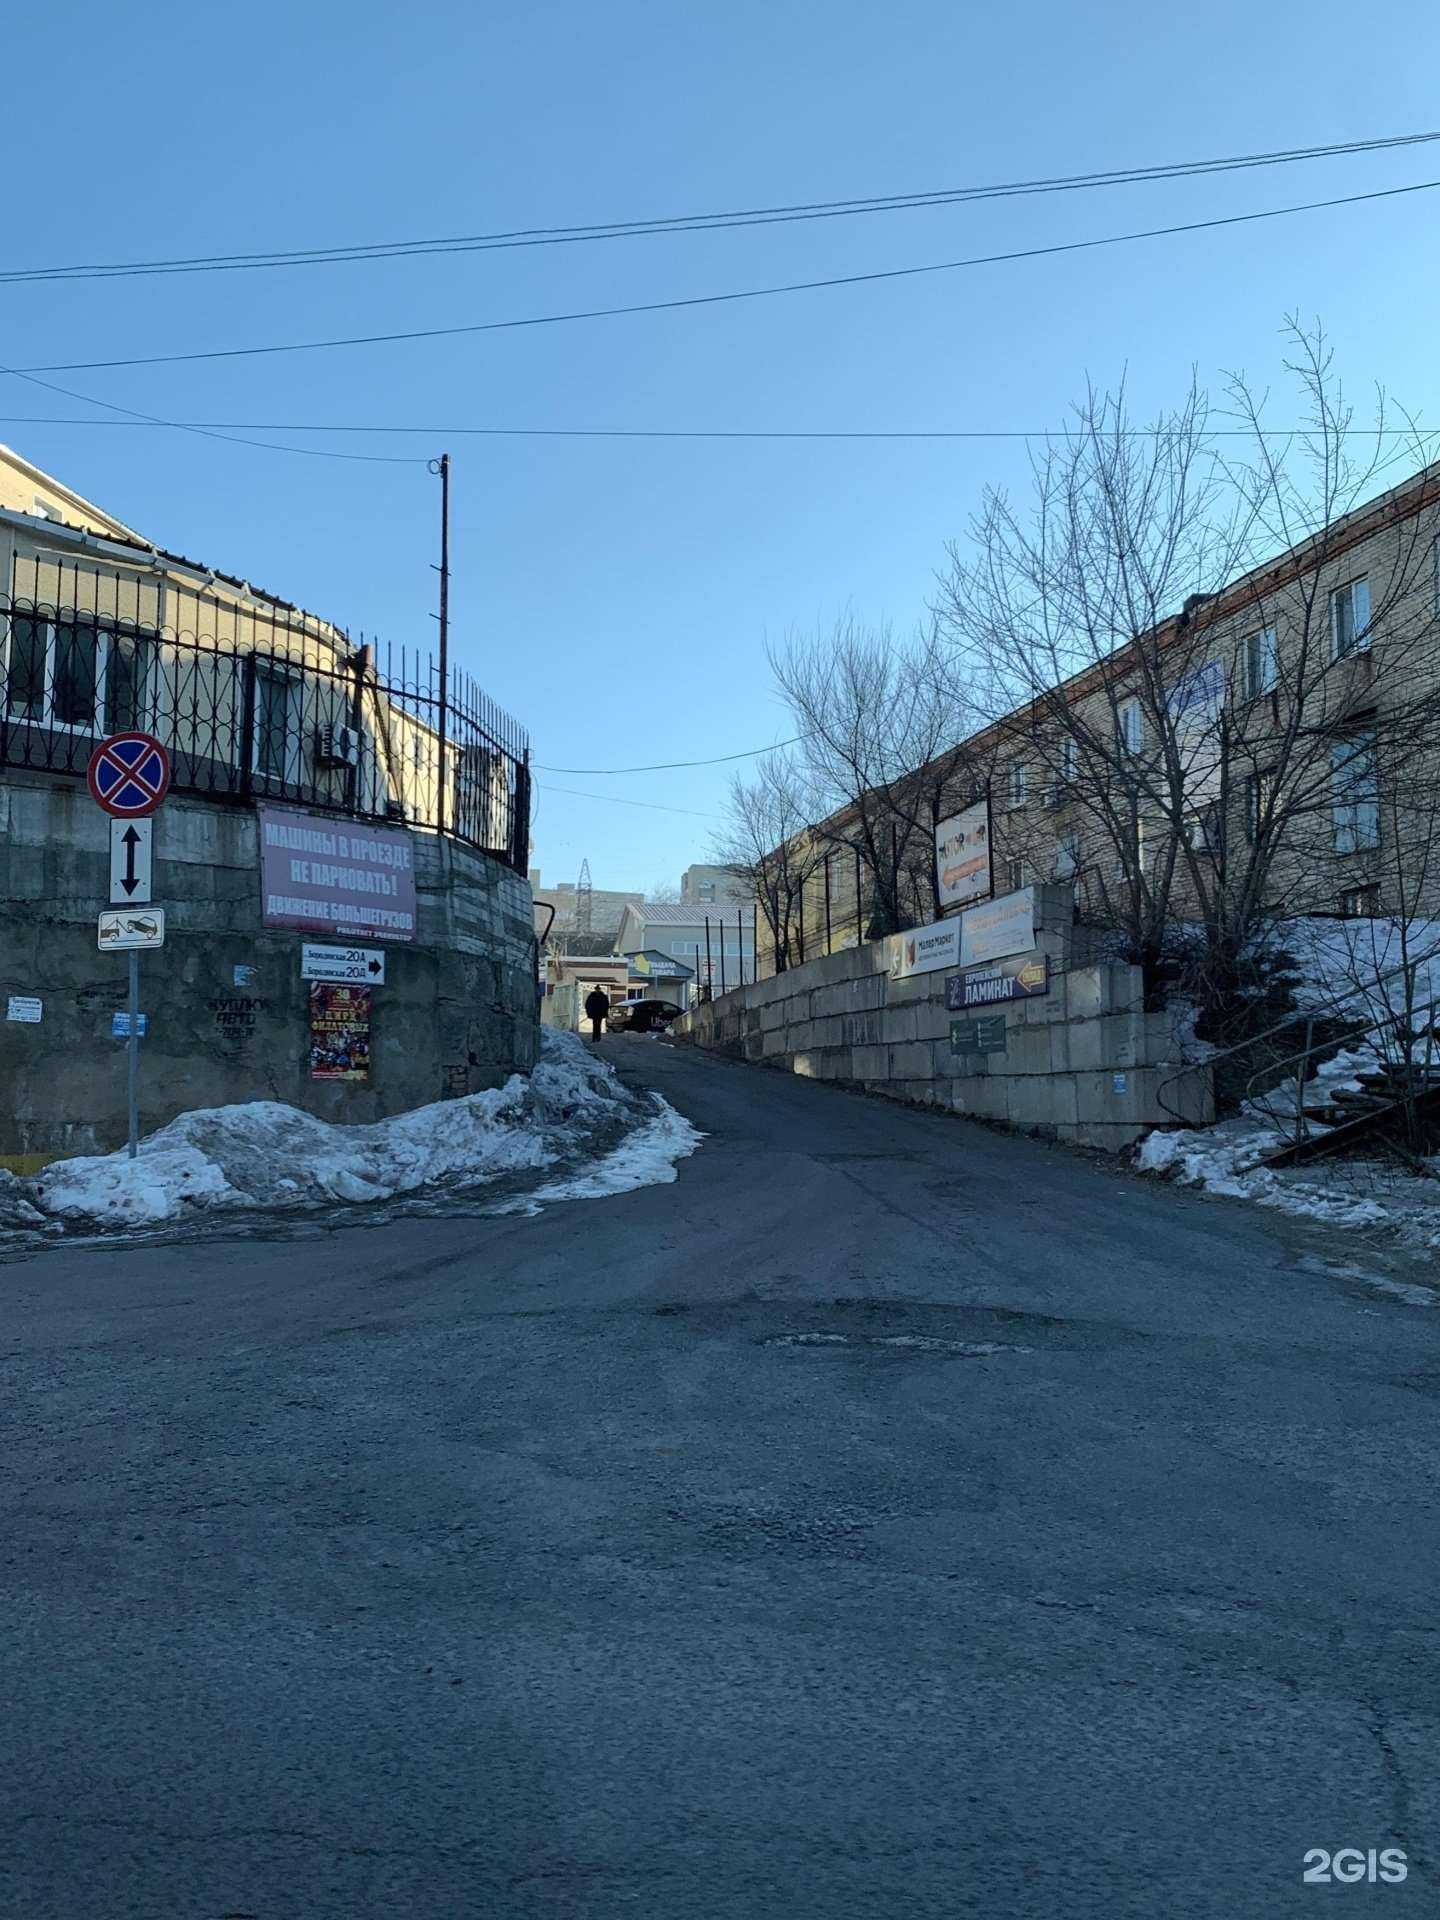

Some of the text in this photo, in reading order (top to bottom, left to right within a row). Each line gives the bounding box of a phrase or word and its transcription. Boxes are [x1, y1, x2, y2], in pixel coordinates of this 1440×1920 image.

[265, 823, 411, 870] МАШИНЫ В ПРОЕЗДЕ
[290, 859, 398, 896] НЕ ПАРКОВАТЬ!
[267, 895, 413, 930] ДВИЖЕНИЕ БОЛЬШЕГРУЗОВ
[965, 976, 1015, 1004] ЛАМИНАТ
